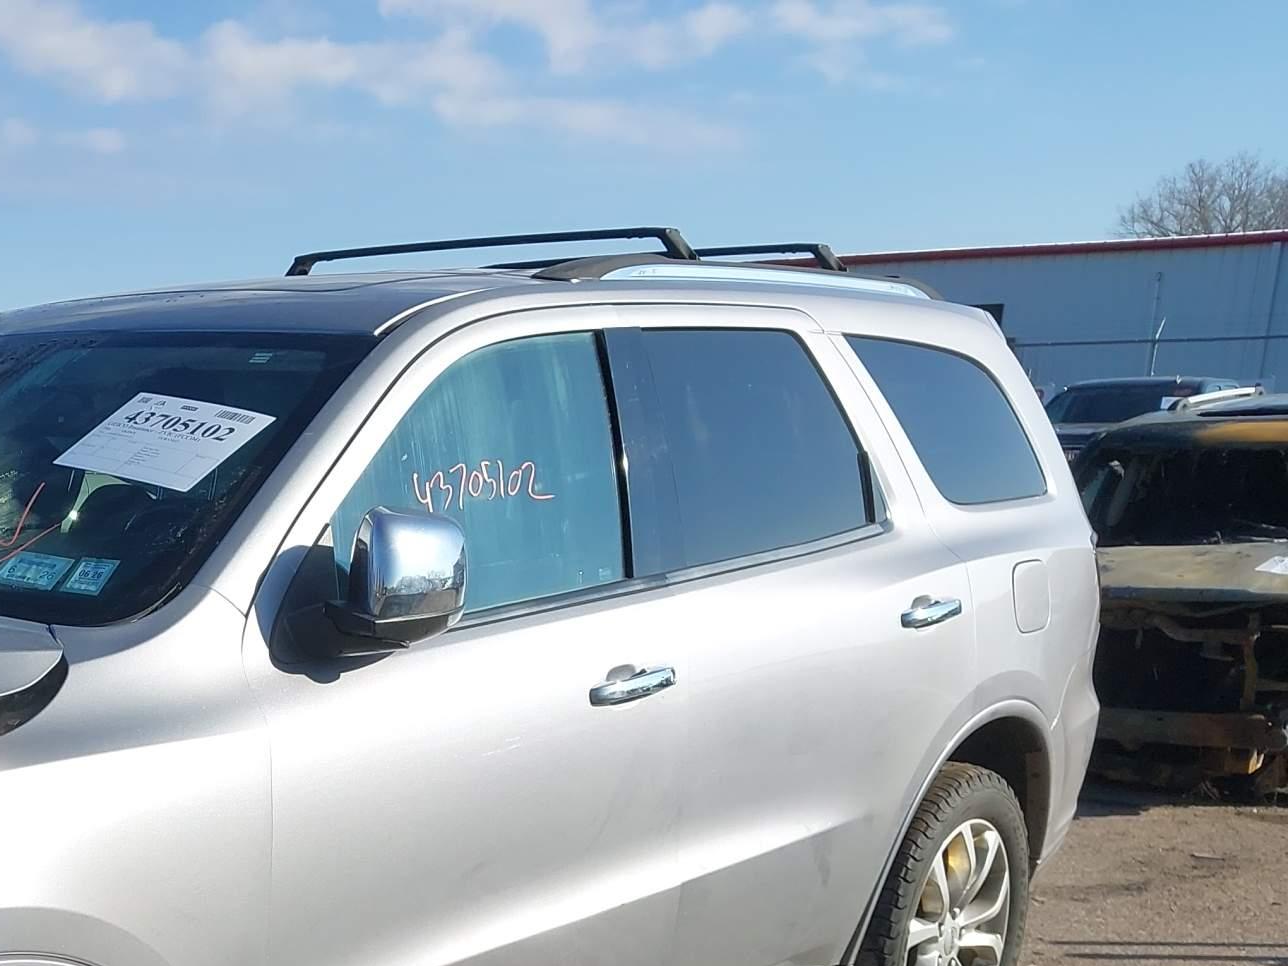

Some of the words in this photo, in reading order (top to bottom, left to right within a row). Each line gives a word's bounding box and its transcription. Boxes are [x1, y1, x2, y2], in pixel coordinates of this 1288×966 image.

[124, 409, 237, 442] 43705102
[412, 460, 556, 513] 43705102
[78, 569, 90, 579] 06
[92, 570, 104, 580] 26
